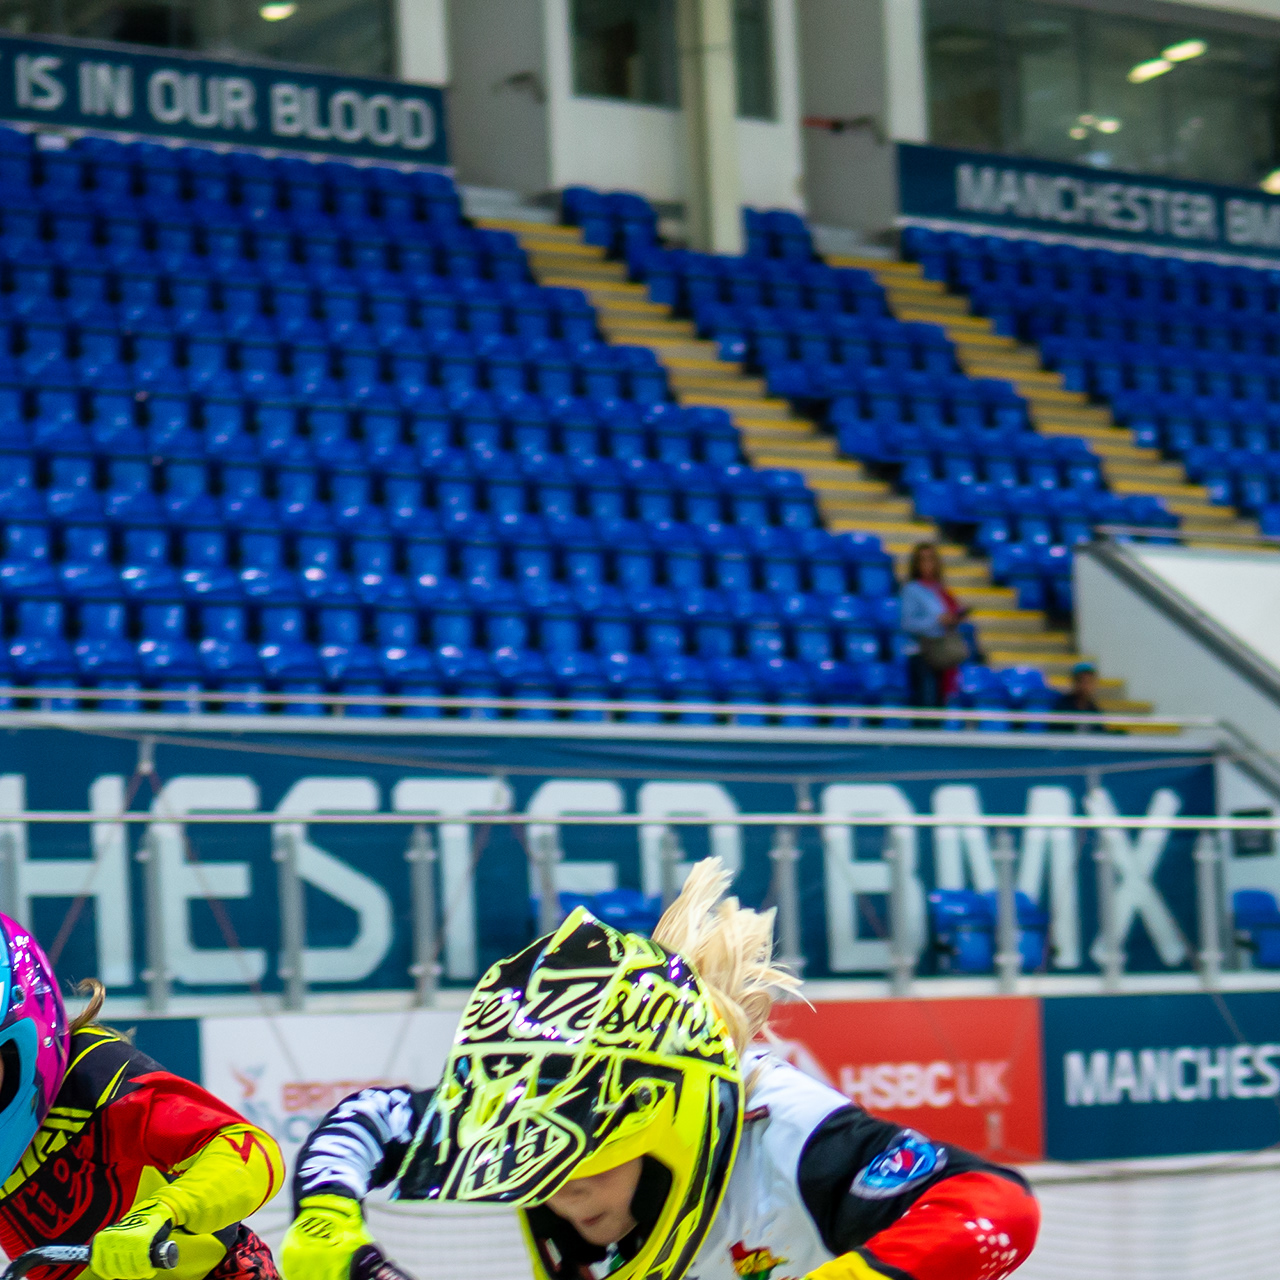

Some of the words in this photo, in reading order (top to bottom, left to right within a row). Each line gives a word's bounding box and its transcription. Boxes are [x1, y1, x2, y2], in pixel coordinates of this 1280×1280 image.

[15, 54, 65, 109] IS
[79, 62, 132, 118] IN
[147, 69, 258, 131] OUR
[271, 84, 436, 150] BLOOD
[954, 162, 1218, 241] MANCHESTER
[821, 782, 1189, 973] BMX
[840, 1060, 955, 1110] HSBC
[958, 1060, 1012, 1104] UK
